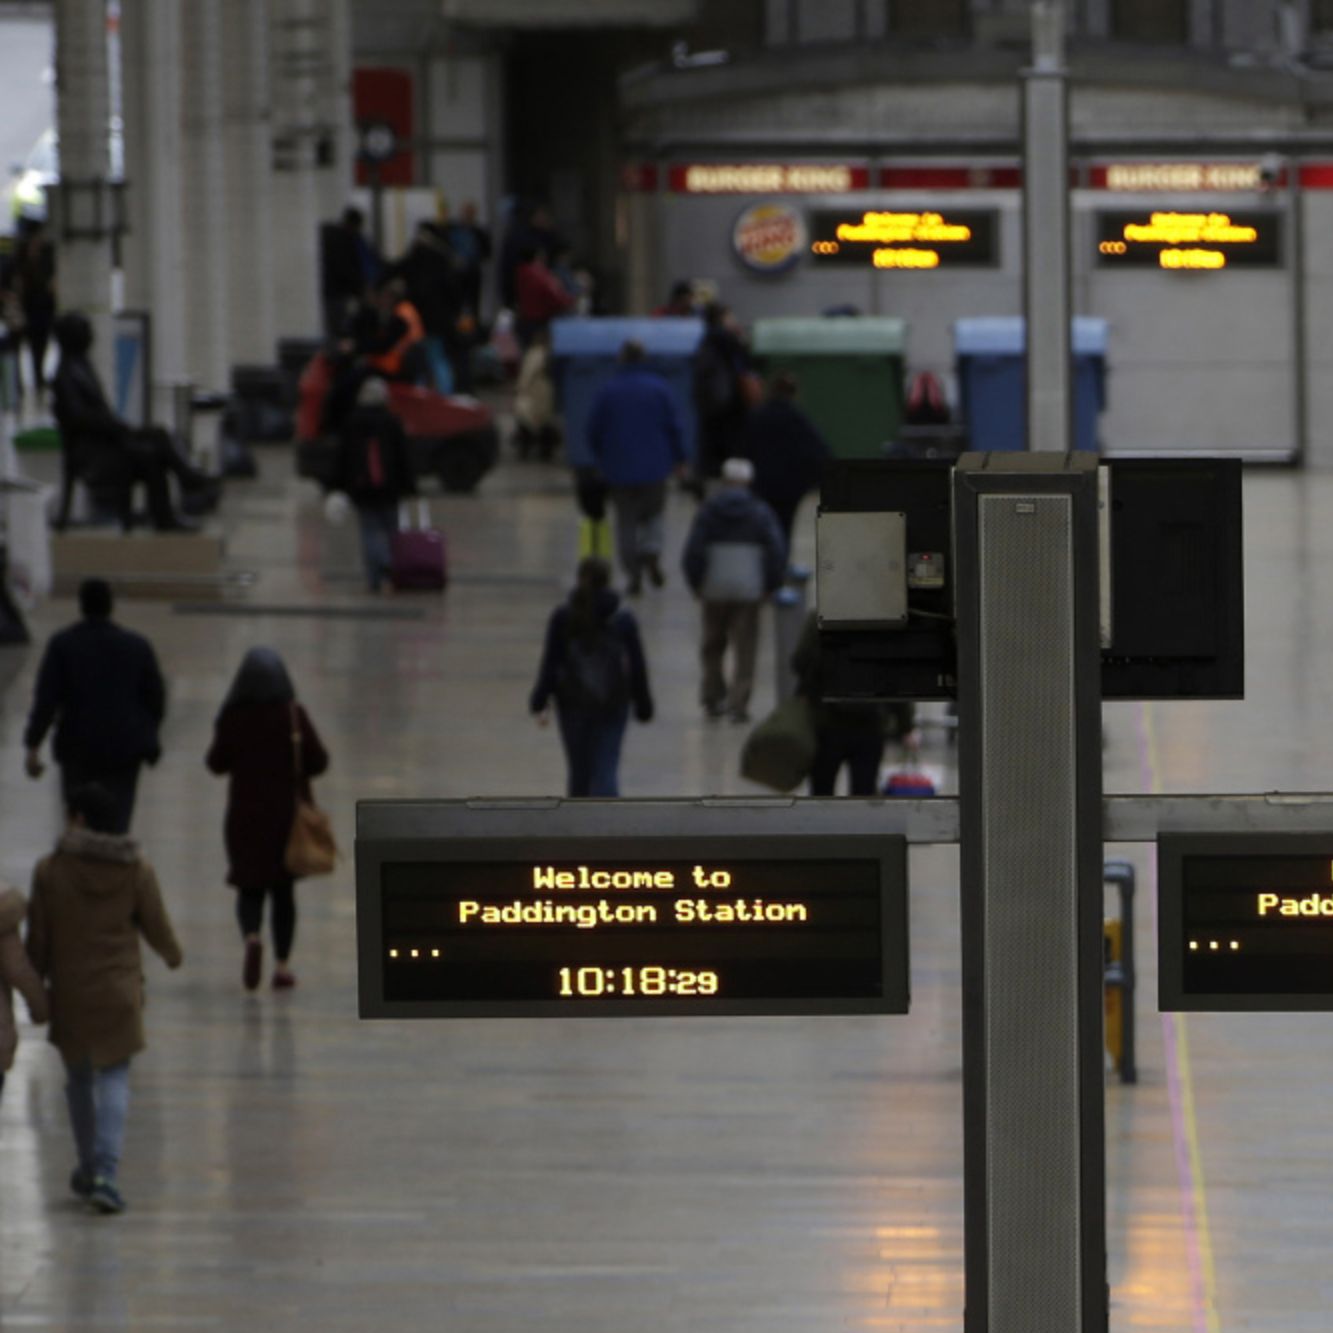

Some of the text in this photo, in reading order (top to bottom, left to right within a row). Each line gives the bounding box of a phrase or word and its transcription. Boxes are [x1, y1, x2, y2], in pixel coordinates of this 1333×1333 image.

[686, 165, 851, 192] BURGER KING
[1108, 164, 1201, 190] BURGER
[533, 866, 731, 889] Welcome to
[459, 900, 806, 928] Paddington Station
[559, 967, 717, 996] 10:18:29
